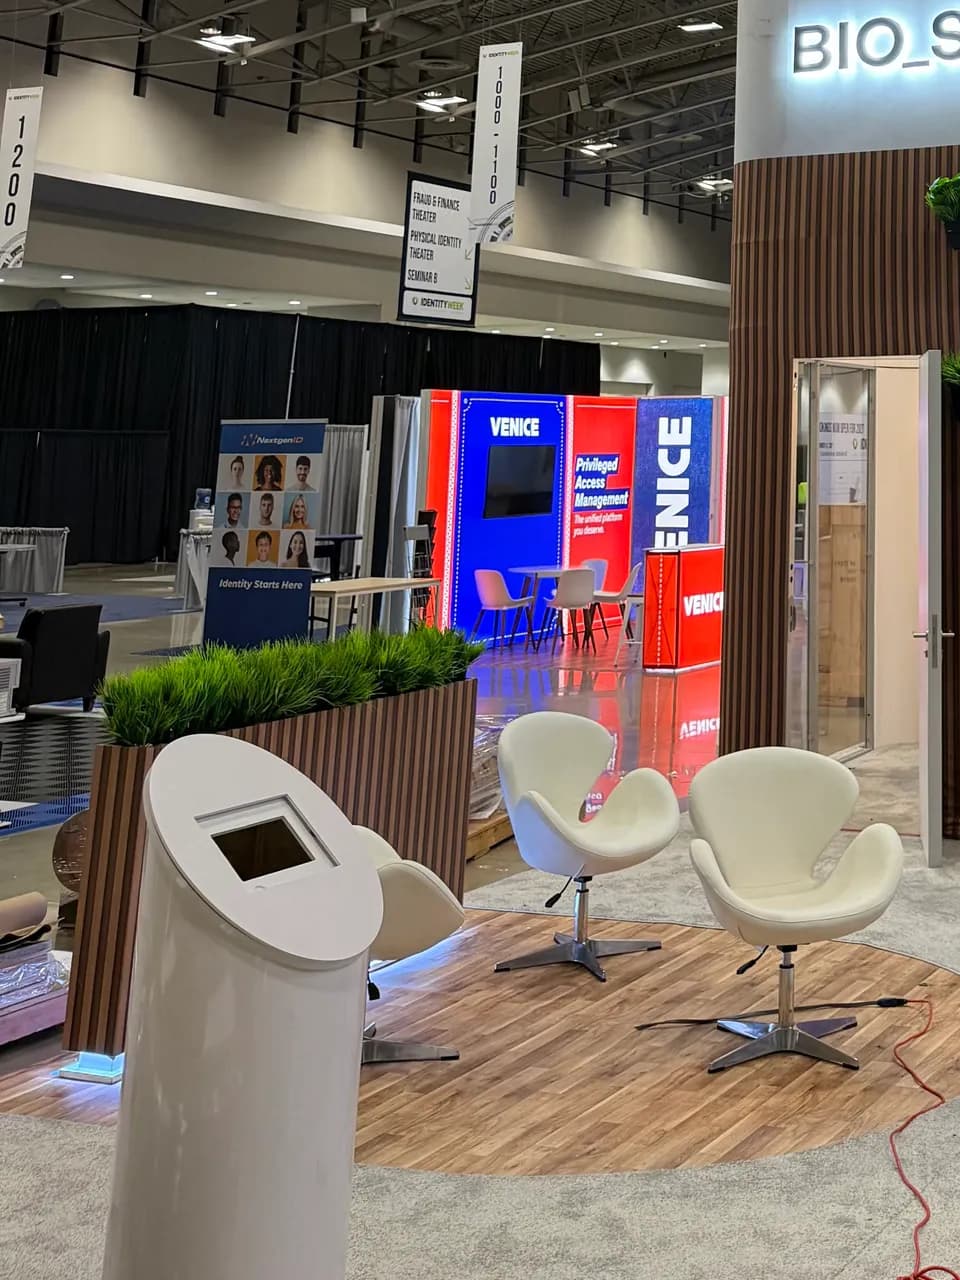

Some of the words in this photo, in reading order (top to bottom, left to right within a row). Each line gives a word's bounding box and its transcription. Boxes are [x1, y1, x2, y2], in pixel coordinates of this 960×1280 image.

[4, 115, 26, 227] 1200
[413, 191, 431, 206] FRAUD
[438, 196, 460, 211] FINANCE
[412, 208, 437, 223] THEATER
[410, 230, 437, 245] PHYSICAL
[437, 234, 462, 249] IDENTITY
[409, 247, 434, 261] THEATER
[407, 269, 433, 283] SEMINAR
[490, 416, 540, 437] VENICE
[575, 456, 618, 475] Privileged
[574, 476, 606, 489] Access
[654, 416, 692, 549] ENICE
[574, 491, 628, 508] Management
[219, 578, 252, 590] Identity
[253, 580, 280, 590] Starts
[281, 580, 303, 590] Here
